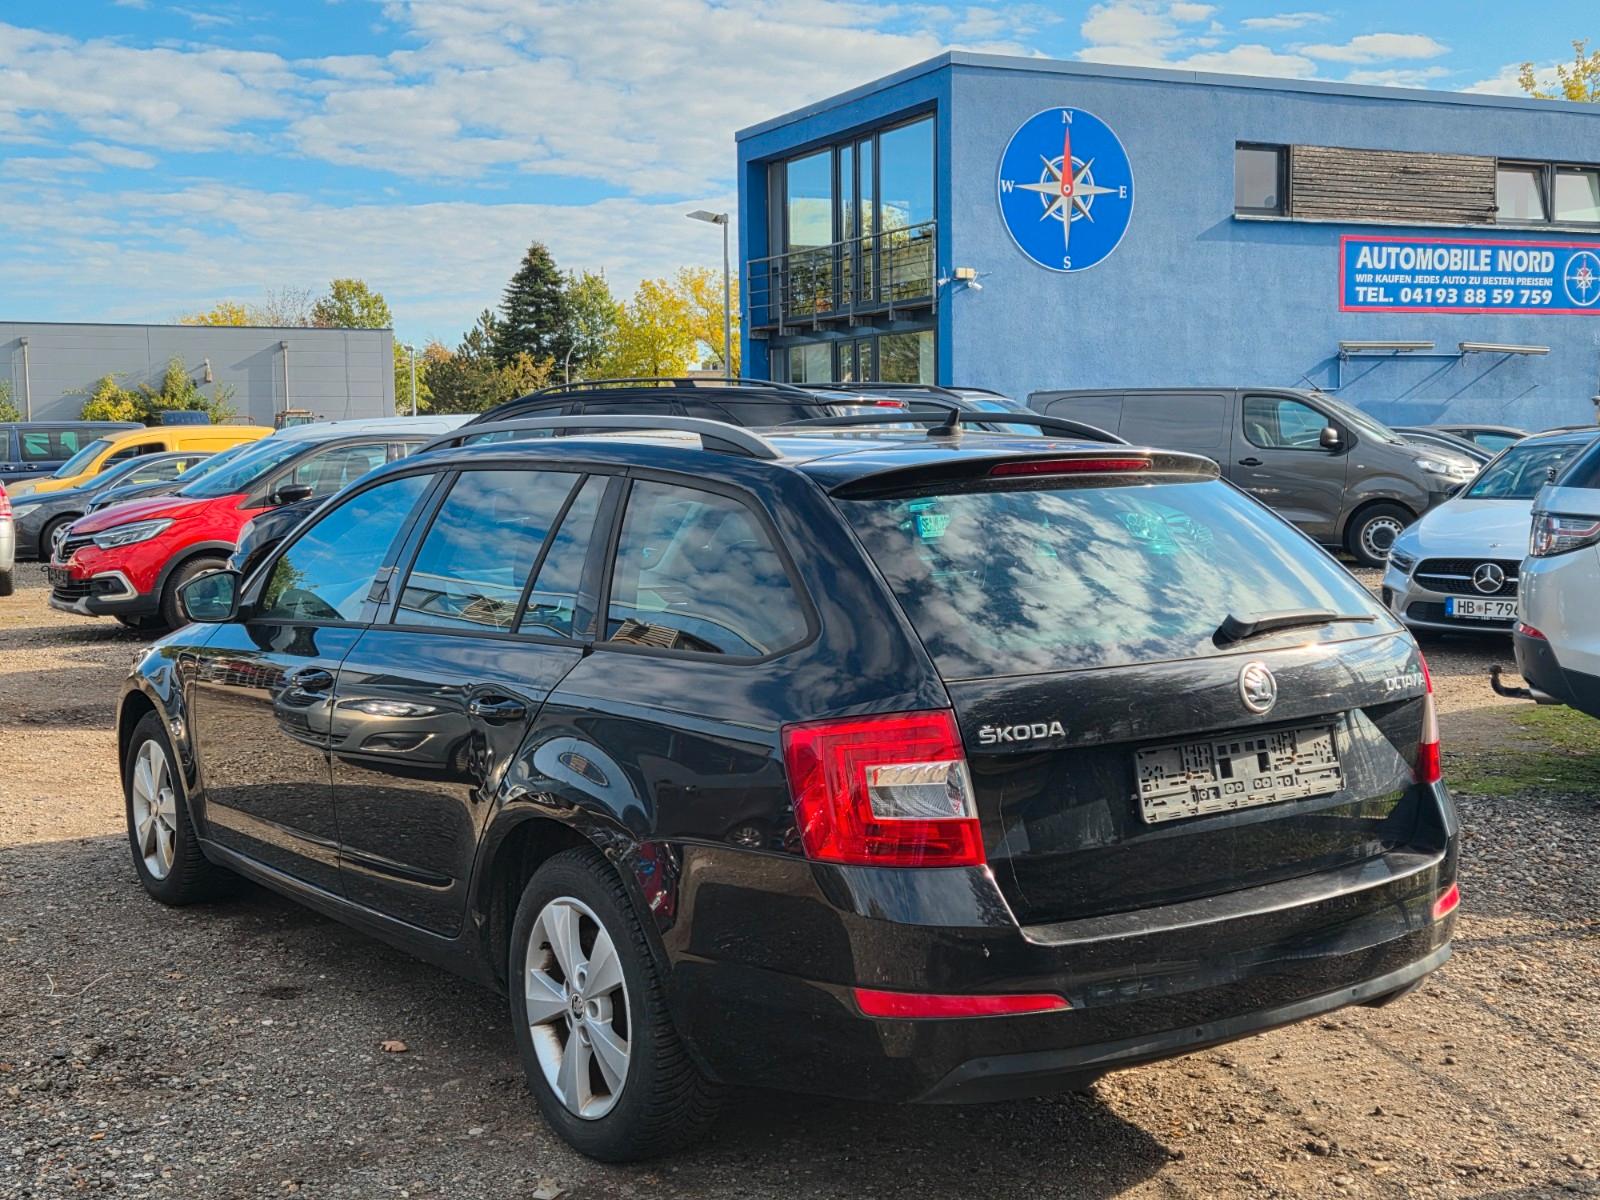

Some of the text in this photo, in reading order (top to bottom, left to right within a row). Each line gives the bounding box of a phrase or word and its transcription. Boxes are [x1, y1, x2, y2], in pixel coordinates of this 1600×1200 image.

[1062, 111, 1073, 124] N
[1001, 180, 1015, 193] W
[1119, 186, 1127, 198] E
[1063, 256, 1072, 269] S
[1356, 246, 1555, 273] AUTOMOBILE NORD
[1356, 273, 1553, 287] WIR KAUFEN JEDES AUTO ZU BESTEN PREISEN!
[1355, 286, 1553, 305] TEL. 04193 88 59 759
[1457, 601, 1475, 614] HB
[1484, 602, 1493, 615] F
[979, 721, 1066, 744] ŠKODA
